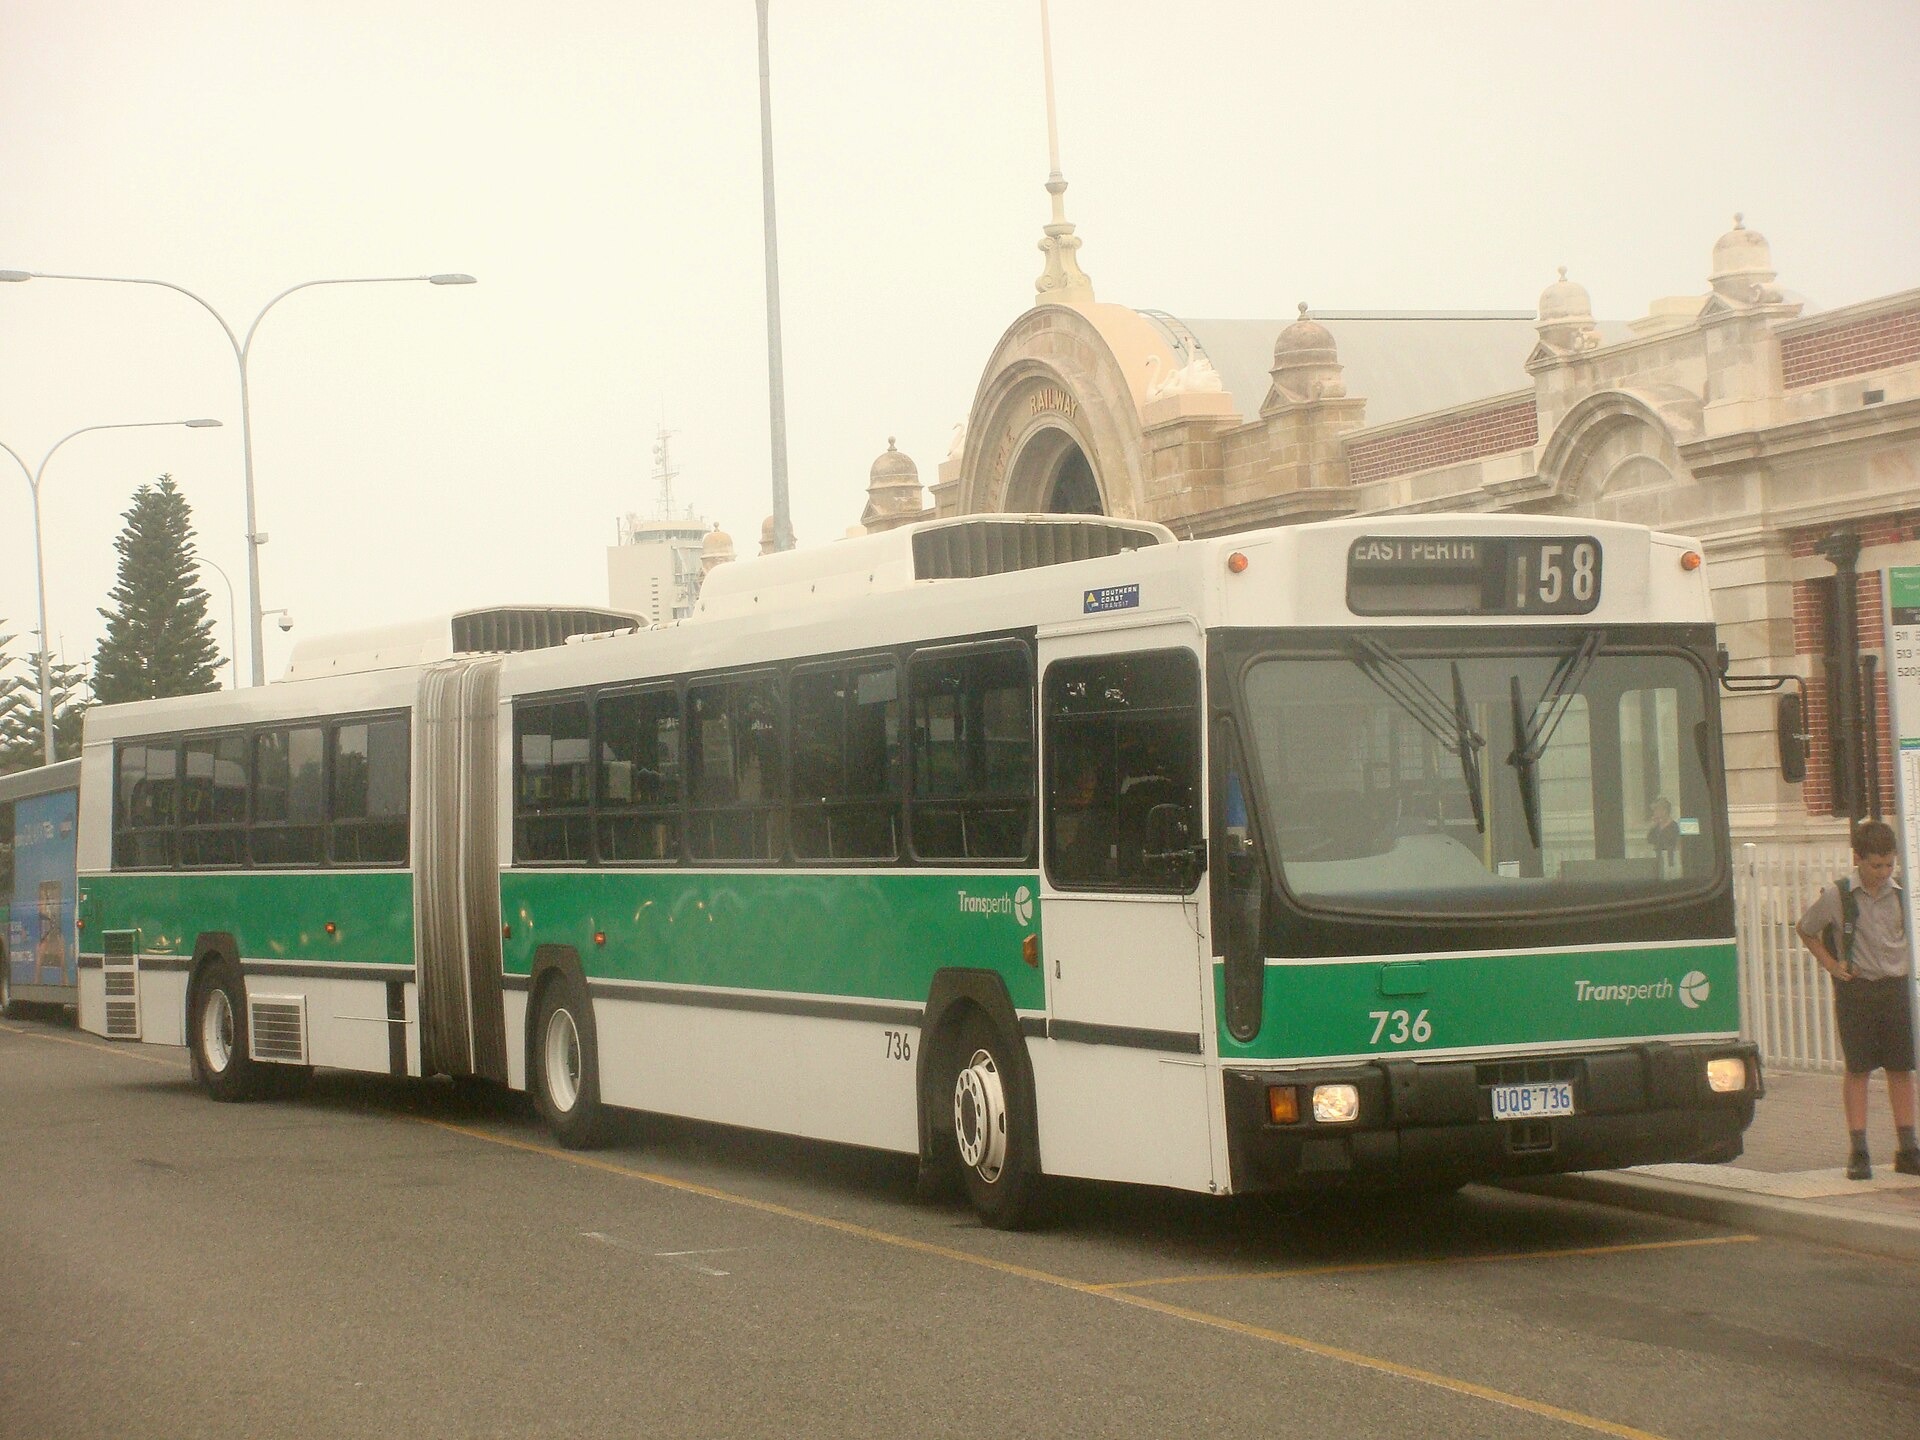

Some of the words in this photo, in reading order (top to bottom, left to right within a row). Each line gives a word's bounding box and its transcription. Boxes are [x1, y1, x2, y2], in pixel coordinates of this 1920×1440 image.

[1030, 388, 1079, 419] RAILWAY
[1355, 542, 1402, 560] EAST
[1411, 541, 1475, 560] PERTH
[1517, 543, 1596, 608] 158
[1101, 586, 1137, 596] SOUTHERN
[1101, 594, 1123, 604] COAST
[1101, 600, 1128, 609] TRANSIT
[958, 890, 1012, 919] Transperth
[1574, 977, 1673, 1006] Transperth
[1368, 1009, 1432, 1045] 736
[884, 1031, 911, 1061] 736
